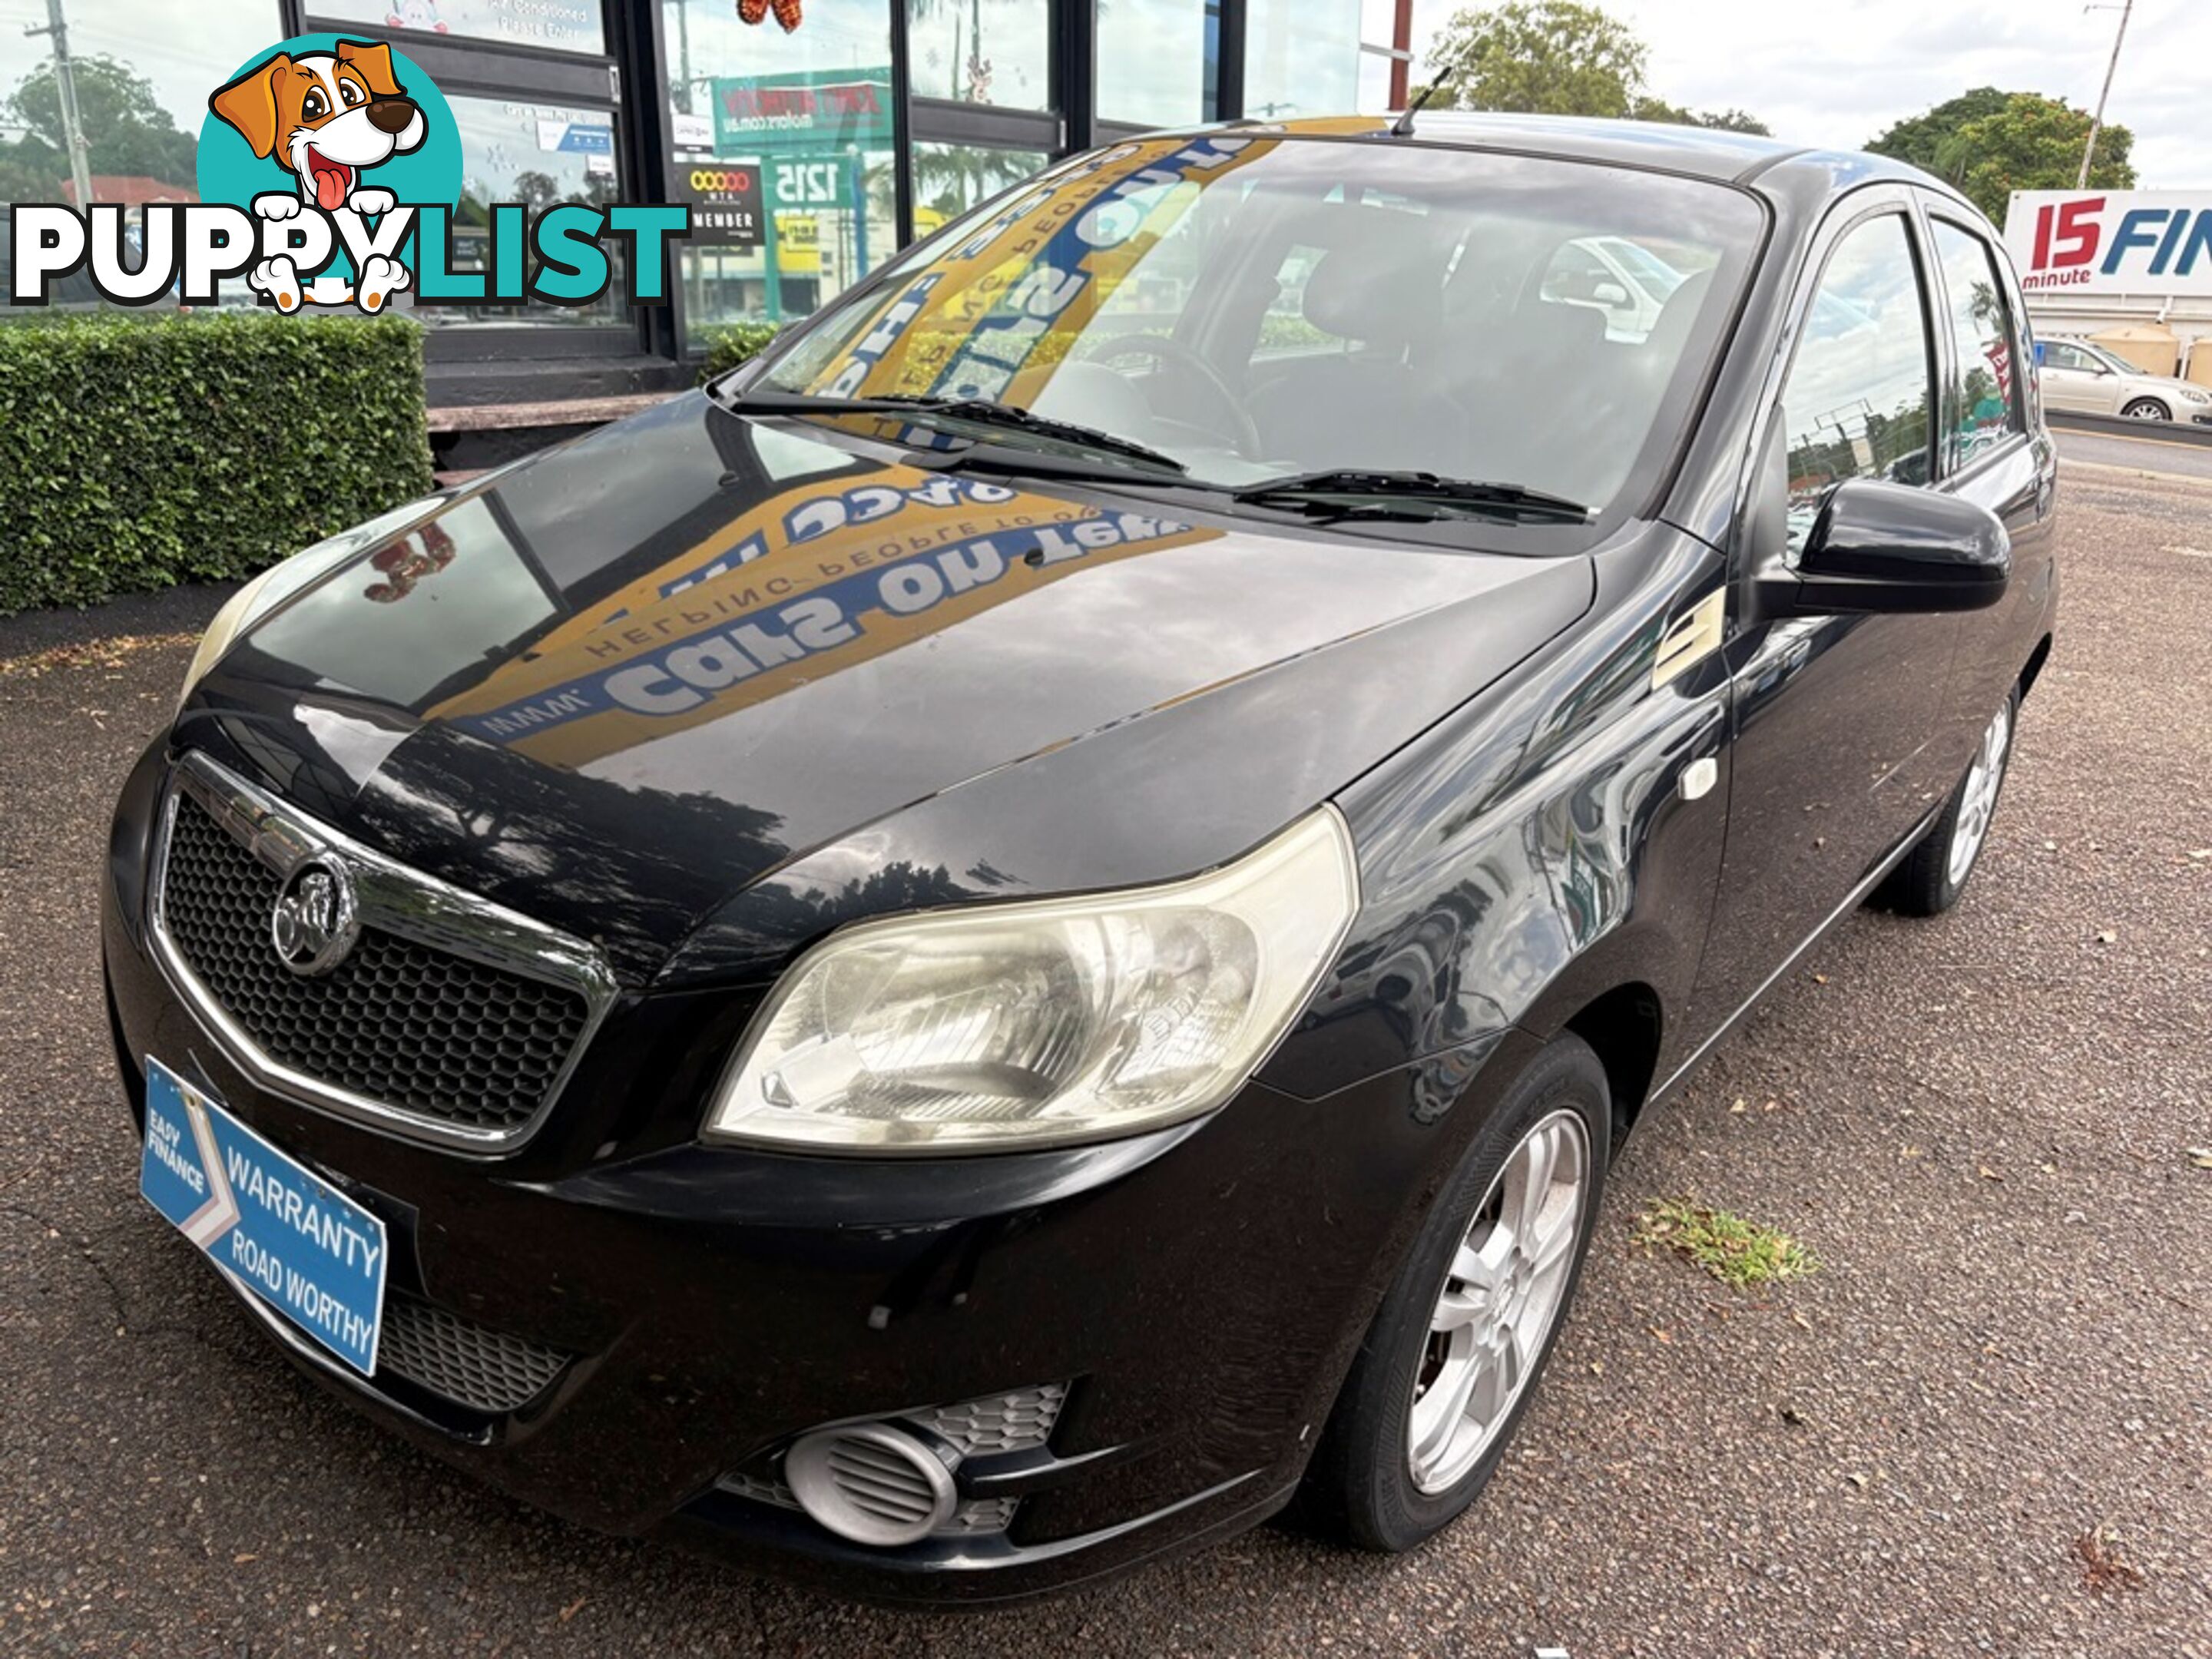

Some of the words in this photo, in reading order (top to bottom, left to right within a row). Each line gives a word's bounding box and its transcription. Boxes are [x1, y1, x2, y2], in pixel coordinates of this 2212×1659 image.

[693, 213, 753, 228] MEMBER
[2031, 196, 2107, 270] 15
[2022, 270, 2091, 290] minute
[149, 1108, 180, 1148] EASY
[147, 1130, 205, 1195] FINANCE
[227, 1146, 380, 1278] WARRANTY
[232, 1230, 281, 1293] ROAD
[286, 1267, 374, 1355] WORTHY
